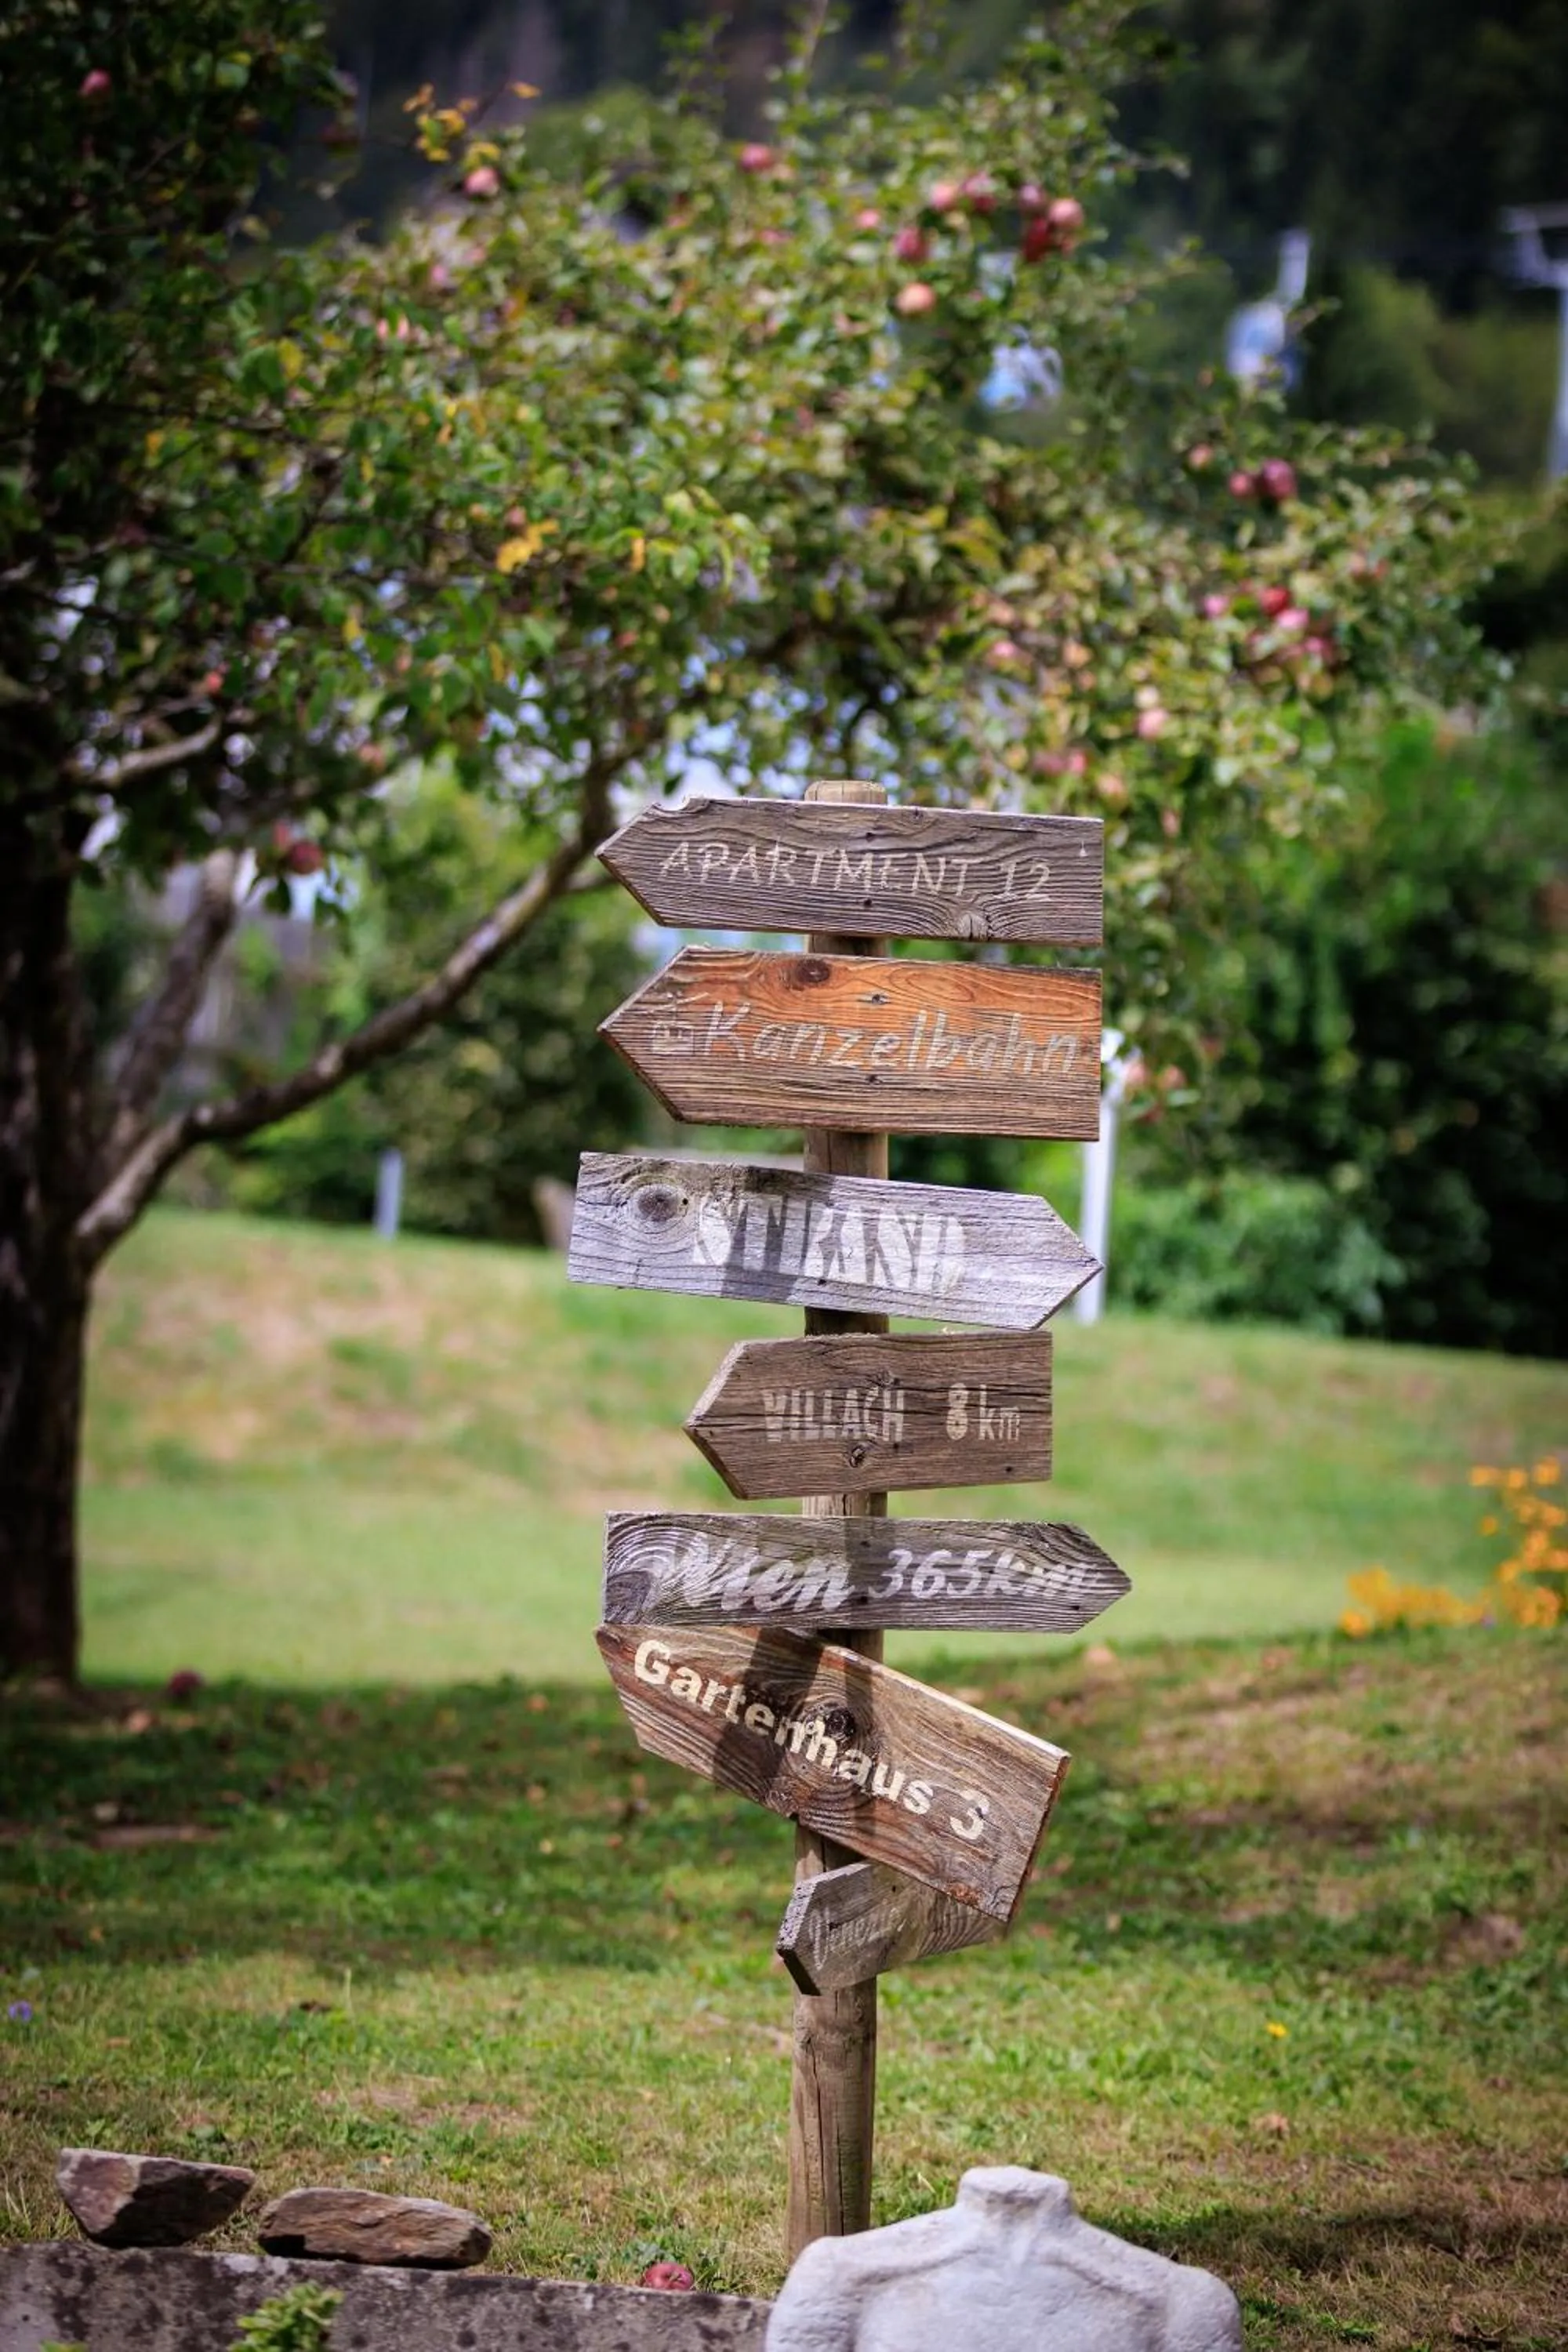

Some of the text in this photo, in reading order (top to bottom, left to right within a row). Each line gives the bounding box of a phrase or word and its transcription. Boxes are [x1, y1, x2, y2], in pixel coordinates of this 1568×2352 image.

[657, 840, 1053, 902] APARTMENT 12
[705, 1000, 1078, 1076] Kanzelbahn
[760, 1382, 1021, 1443] VILLACH 8 km
[633, 1639, 990, 1842] Gartenhaus 3
